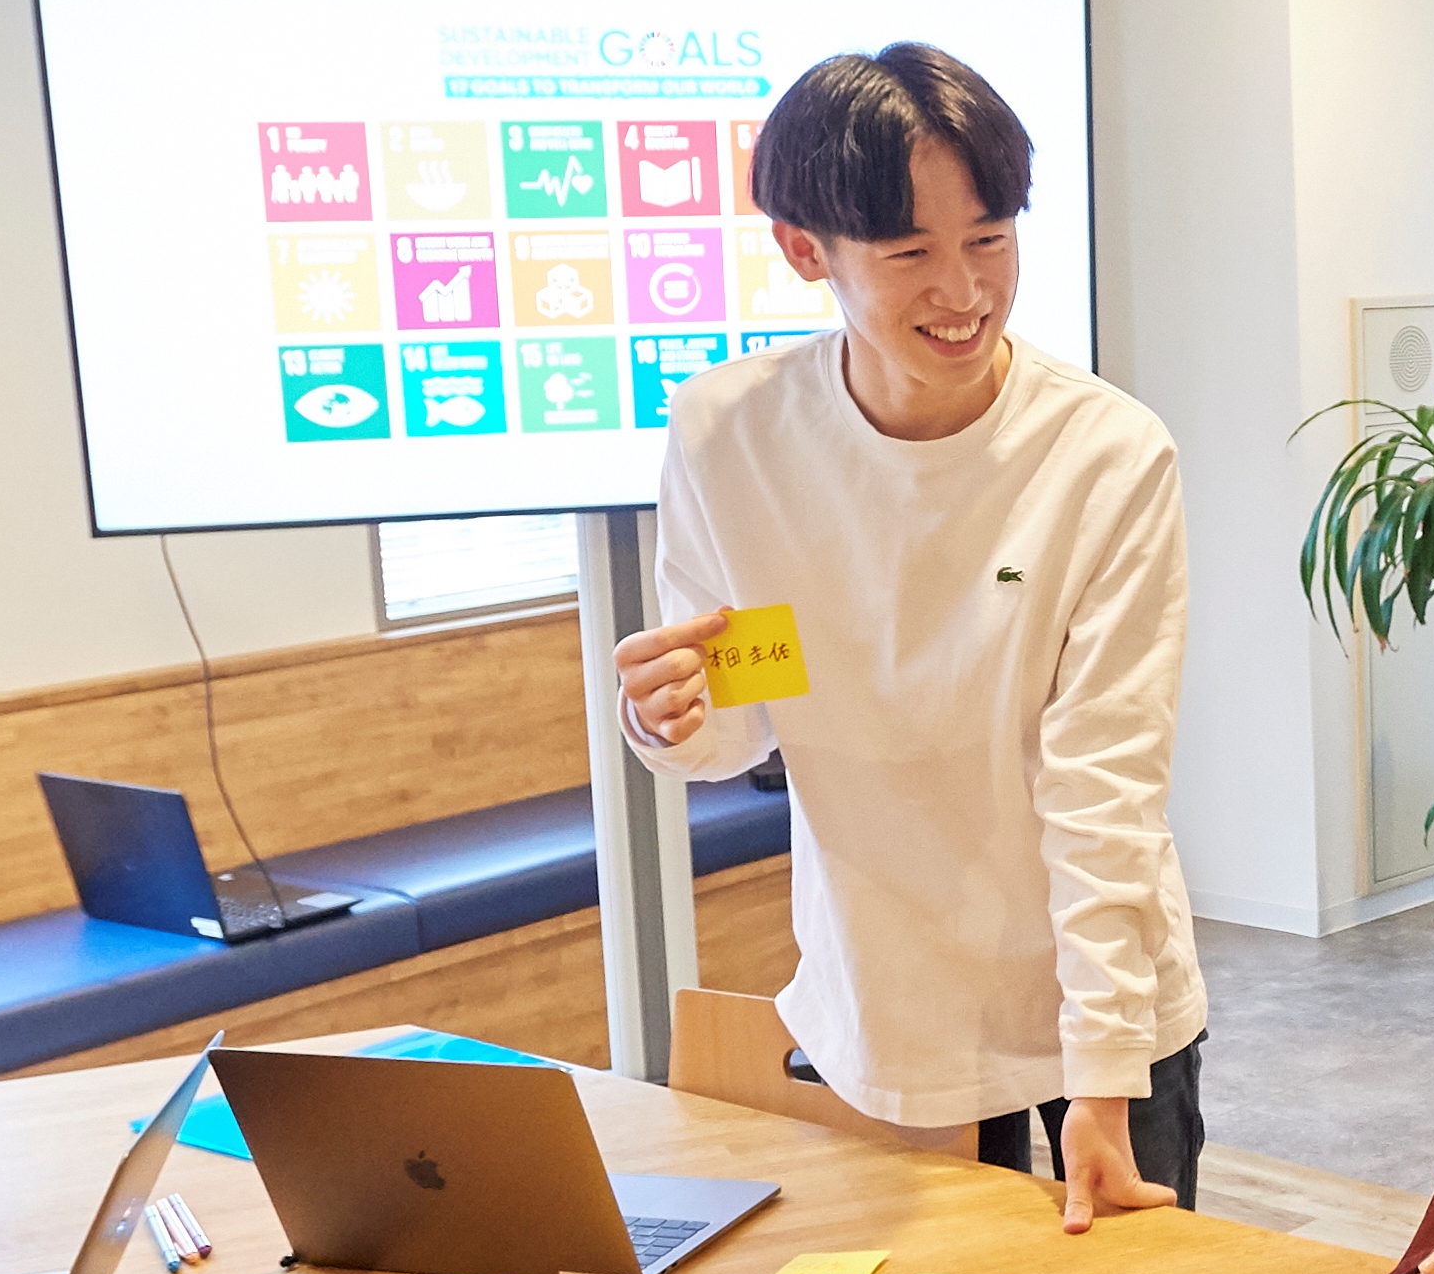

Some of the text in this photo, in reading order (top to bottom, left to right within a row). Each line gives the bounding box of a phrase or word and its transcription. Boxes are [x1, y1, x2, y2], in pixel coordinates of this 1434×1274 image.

[439, 27, 588, 44] SUSTAINABLE
[599, 30, 763, 66] GOALS
[439, 48, 590, 66] DEVELOPMENT
[471, 79, 530, 94] GOALS
[532, 79, 557, 94] TO
[560, 79, 658, 94] TRANSFORM
[661, 79, 696, 94] OUR
[698, 79, 760, 94] WORLD
[267, 126, 280, 153] 1
[389, 126, 404, 152] 2
[509, 125, 523, 151] 3
[624, 125, 639, 150] 4
[737, 124, 751, 149] 5
[277, 238, 289, 265] 7
[397, 236, 412, 263] 8
[514, 235, 530, 260] 9
[628, 233, 650, 257] 10
[282, 349, 306, 376] 13
[403, 345, 428, 372] 14
[521, 342, 542, 367] 15
[634, 339, 657, 363] 16
